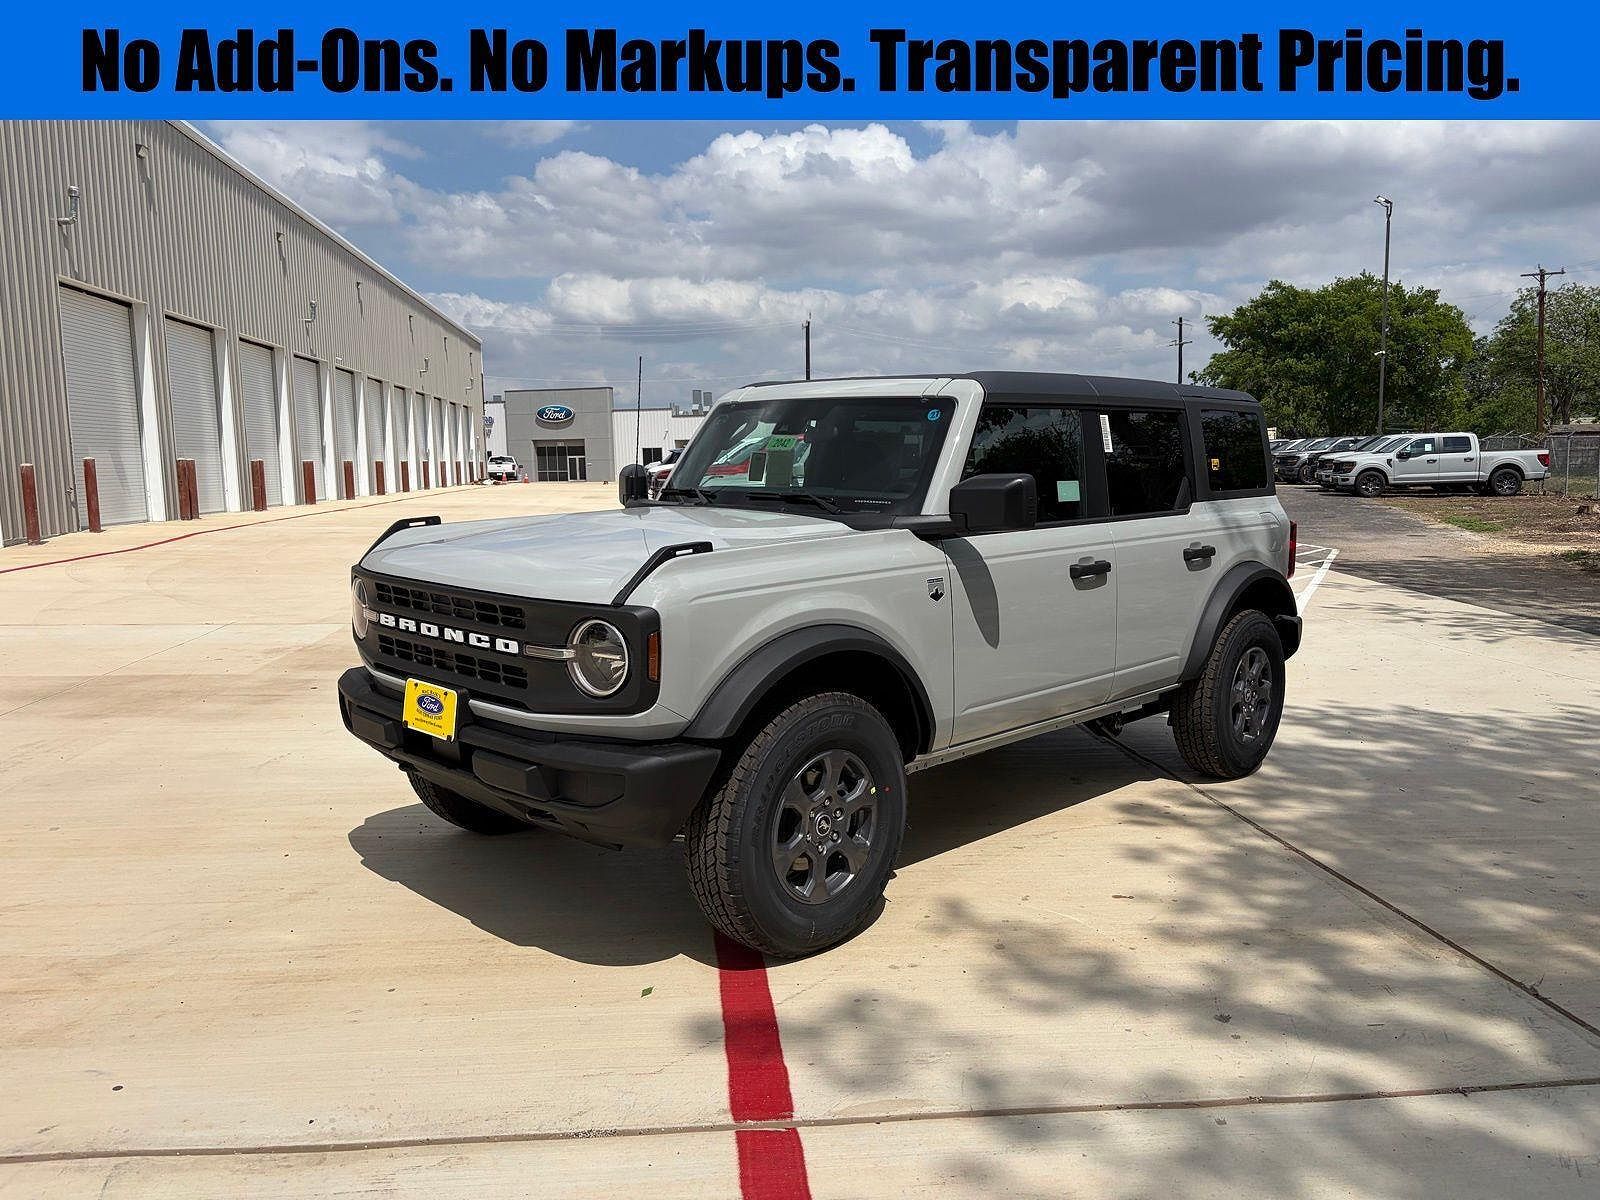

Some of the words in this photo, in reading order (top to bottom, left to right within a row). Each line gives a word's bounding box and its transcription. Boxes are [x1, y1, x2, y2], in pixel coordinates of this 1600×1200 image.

[542, 406, 567, 420] Ford
[379, 613, 520, 655] BRONCO
[421, 695, 440, 712] Ford
